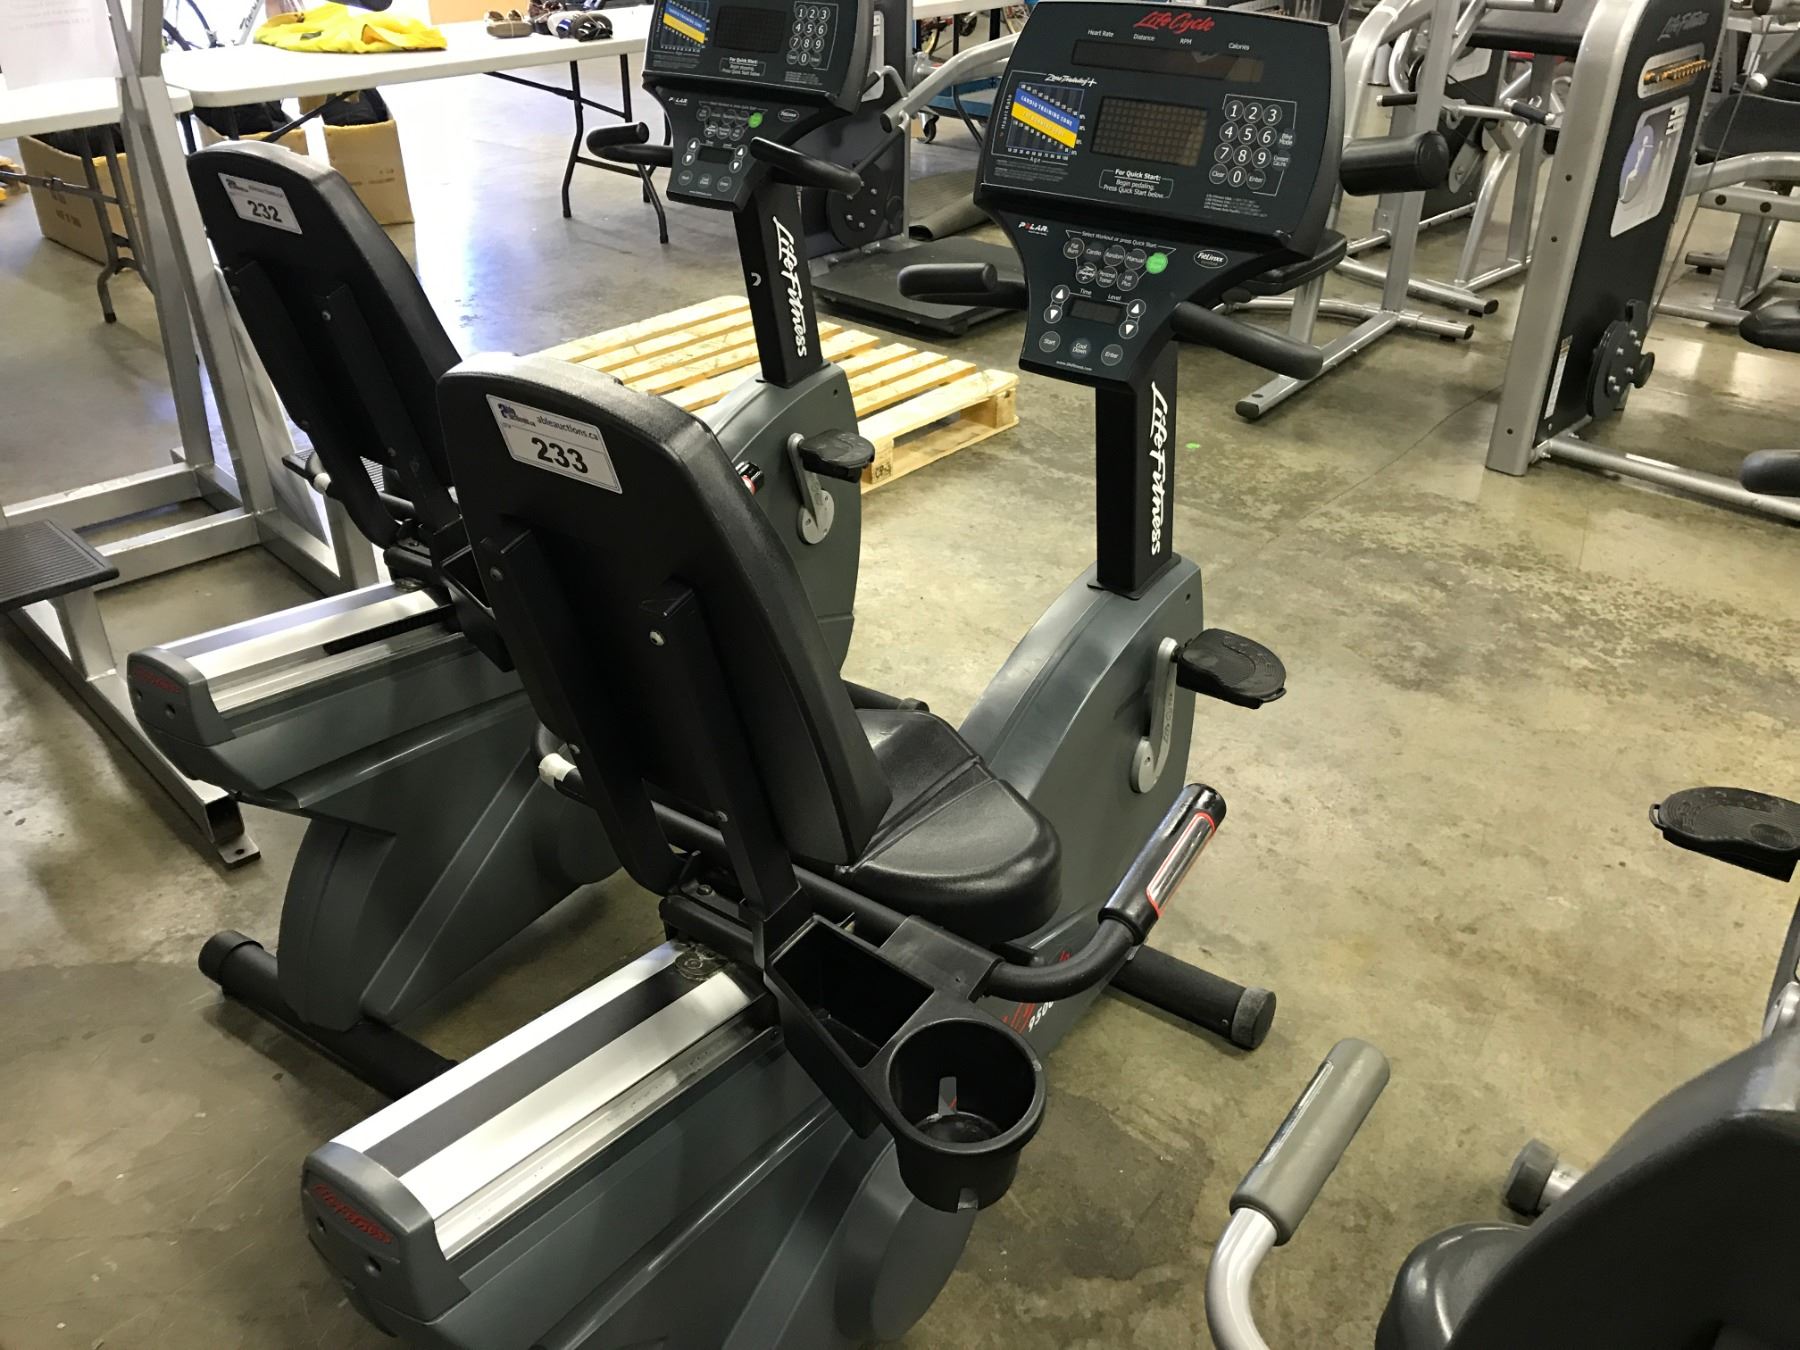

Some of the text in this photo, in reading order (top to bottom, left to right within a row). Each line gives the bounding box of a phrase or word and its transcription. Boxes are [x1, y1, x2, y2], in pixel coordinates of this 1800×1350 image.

[809, 9, 816, 19] 2
[820, 9, 827, 20] 3
[806, 23, 813, 34] 5
[818, 25, 824, 35] 6
[1087, 29, 1115, 38] Heart Rate
[1133, 33, 1156, 42] Distance
[1179, 37, 1193, 46] RPM
[803, 38, 810, 48] 8
[815, 39, 822, 50] 9
[1227, 42, 1251, 51] Calories
[1020, 95, 1038, 108] CARDIO
[1038, 104, 1060, 120] TRAINING
[1229, 104, 1277, 122] 1 2 3
[1224, 126, 1272, 144] 4 5 6
[1219, 146, 1230, 160] 7
[1237, 149, 1248, 163] 8
[1256, 151, 1267, 165] 9
[1115, 168, 1126, 176] For
[1126, 170, 1144, 179] Quick
[1232, 170, 1242, 184] 0
[1115, 179, 1131, 187] Begin
[1103, 184, 1118, 192] Press
[1133, 188, 1147, 197] Start
[247, 200, 283, 223] 232
[1081, 230, 1096, 239] Select
[1132, 239, 1145, 247] Quick
[1080, 288, 1092, 296] Time
[1043, 338, 1056, 346] Start
[1075, 342, 1088, 350] Cool
[1072, 347, 1087, 355] Down
[531, 437, 589, 474] 233
